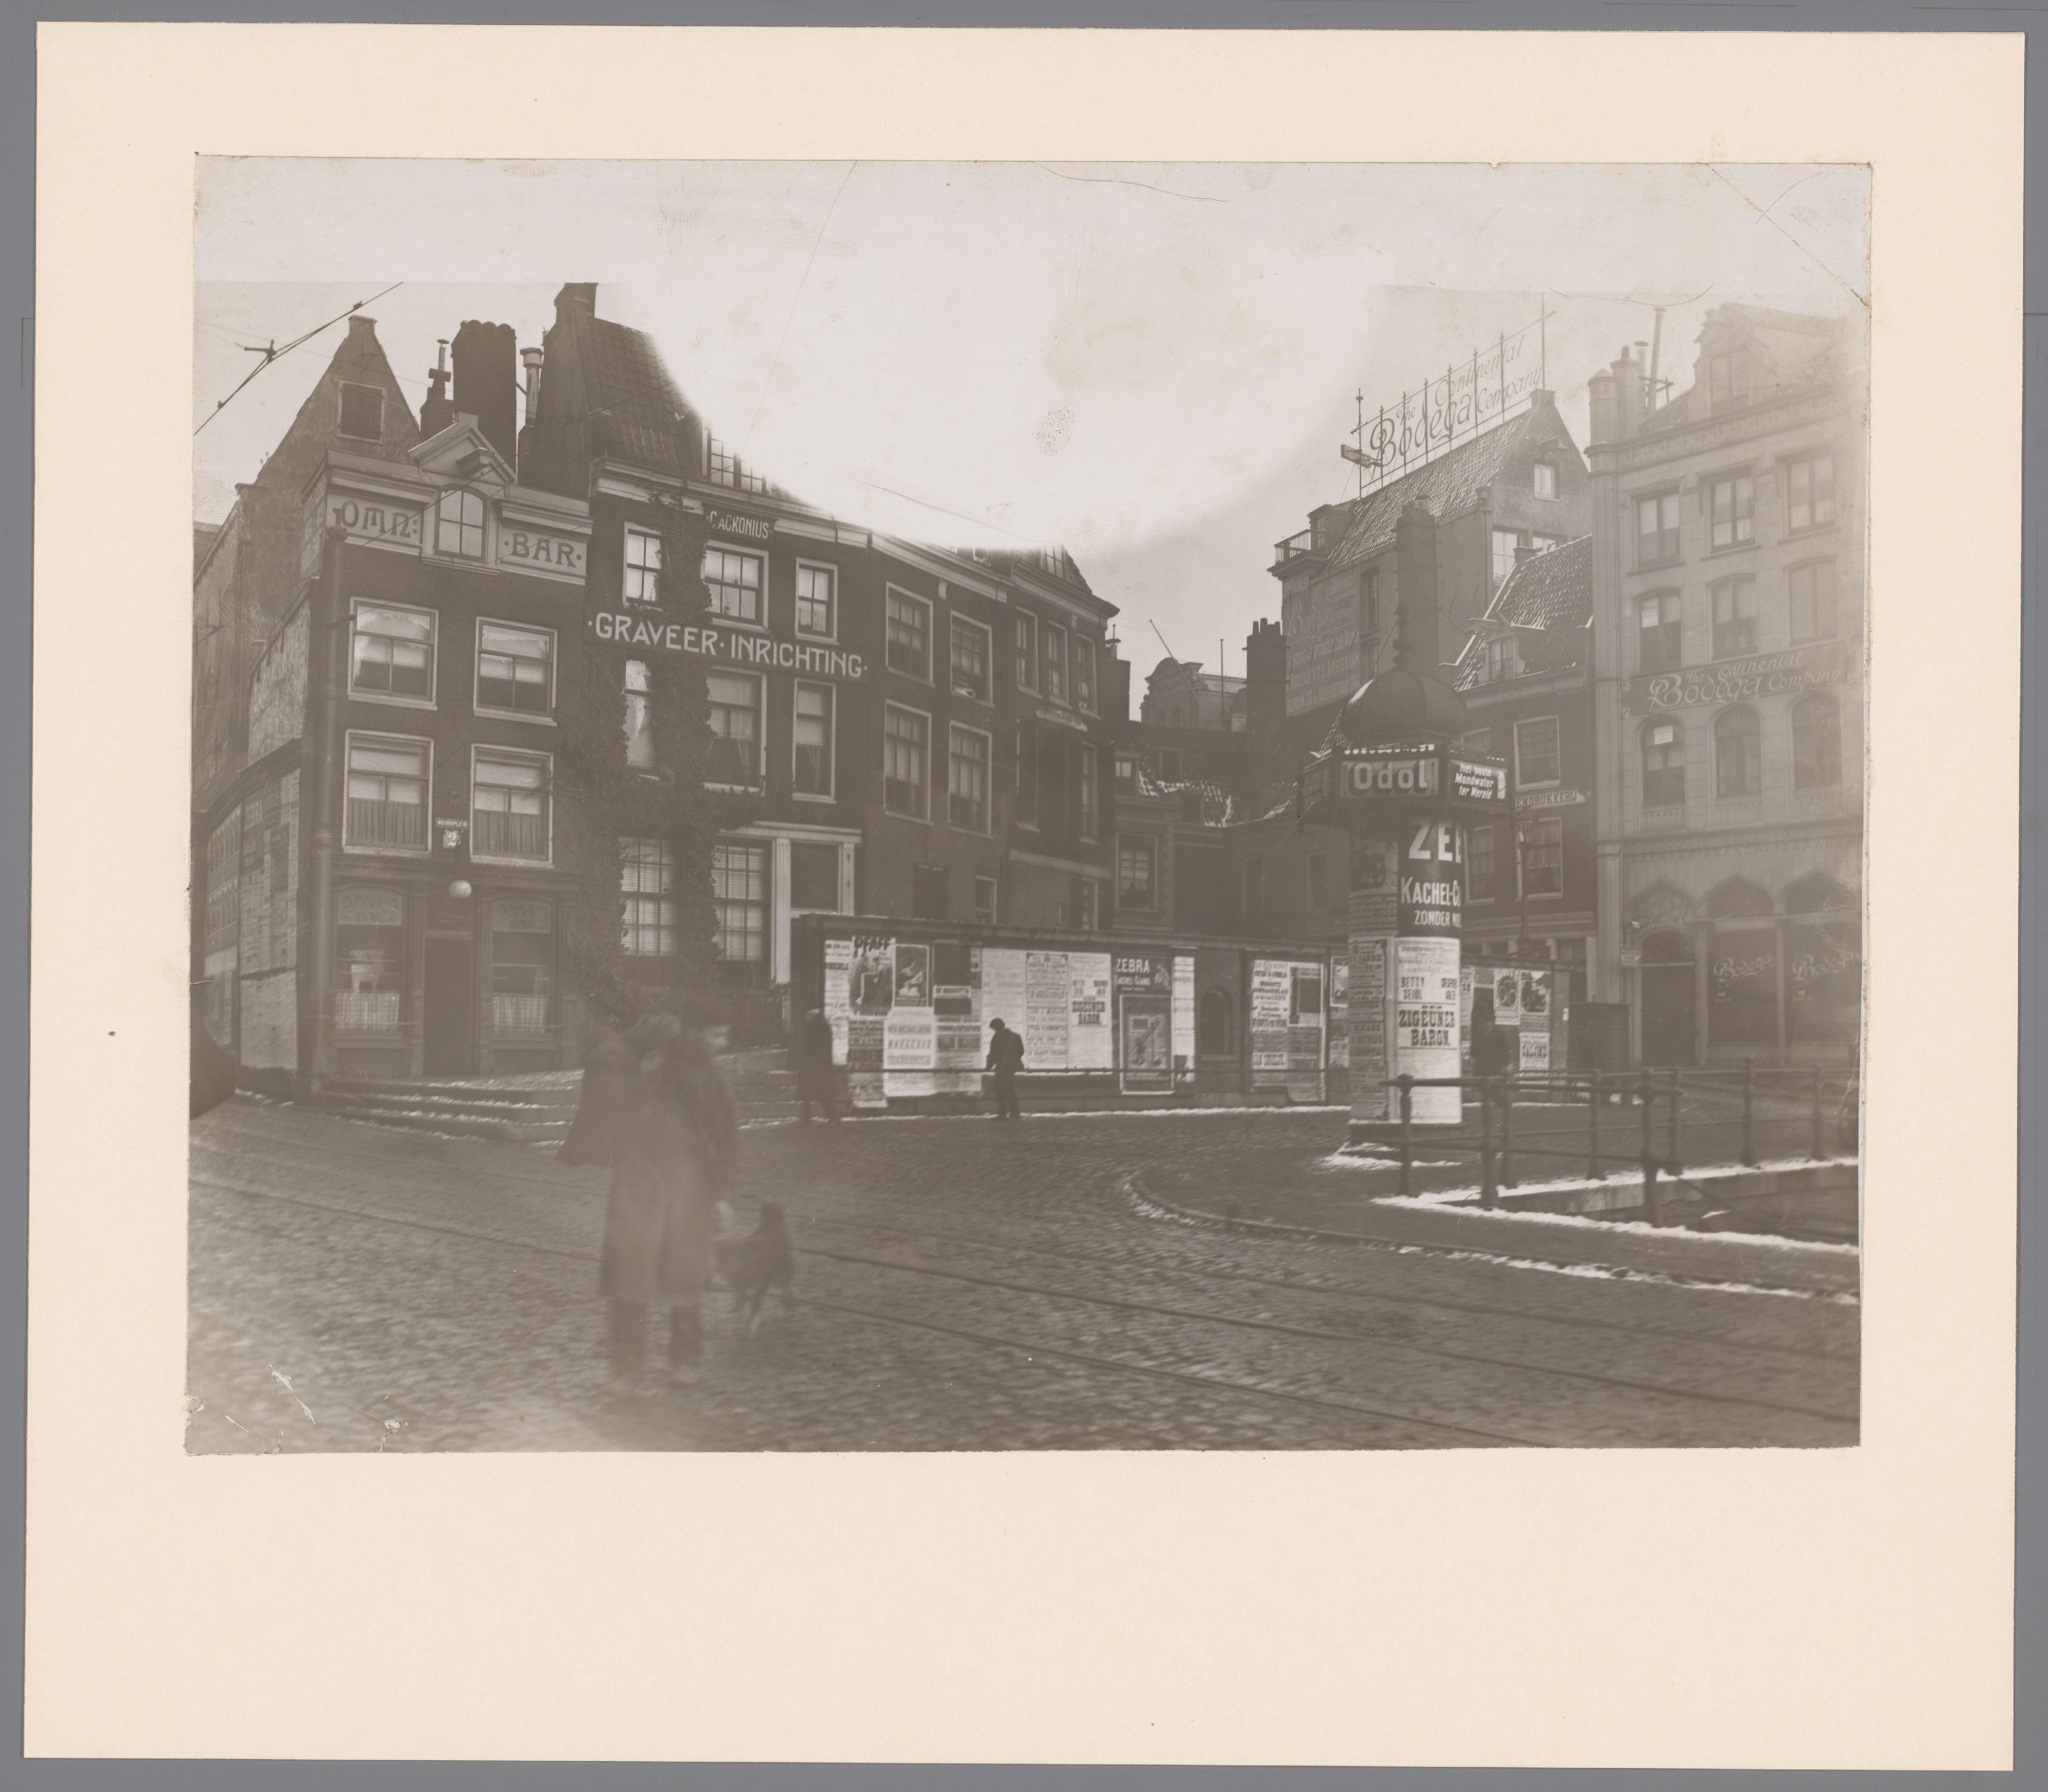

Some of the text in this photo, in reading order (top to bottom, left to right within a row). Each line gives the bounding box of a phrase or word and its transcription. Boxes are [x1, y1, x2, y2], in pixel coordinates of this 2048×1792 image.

[1370, 365, 1542, 468] Bodega Company
[718, 514, 769, 539] ACRONIUS
[510, 532, 576, 568] BAR
[596, 612, 862, 678] GRAVEER INRICHTING
[1718, 652, 1802, 681] Continental
[1647, 667, 1842, 712] Bodega Company
[1351, 759, 1428, 794] Odol
[1454, 772, 1494, 788] Mondwater
[1470, 786, 1494, 800] Wereld
[1414, 910, 1450, 926] ZONDER
[1116, 958, 1150, 974] ZEBRA
[1399, 1010, 1455, 1028] ZIGEUNER
